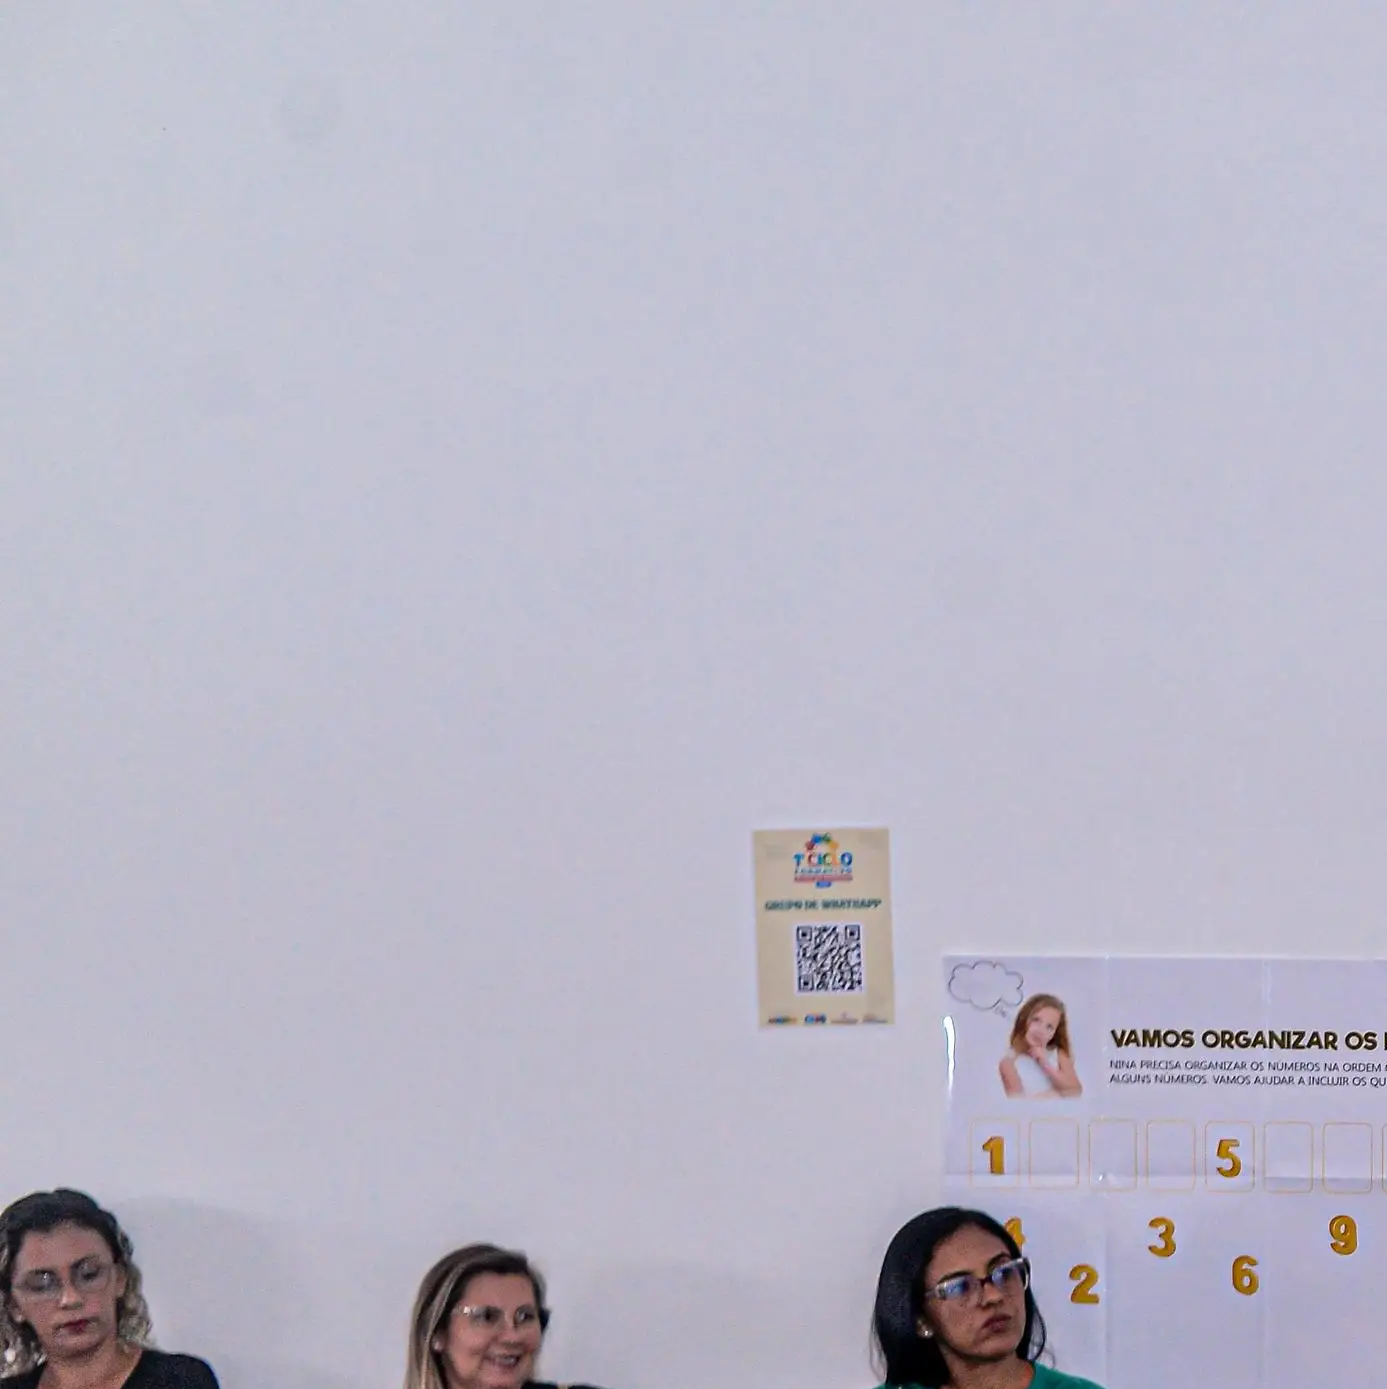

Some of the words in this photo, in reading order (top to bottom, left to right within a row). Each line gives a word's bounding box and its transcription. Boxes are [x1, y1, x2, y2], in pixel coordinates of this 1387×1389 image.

[1110, 1028, 1195, 1049] VAMOS
[1201, 1029, 1338, 1050] ORGANIZAR
[1345, 1031, 1377, 1051] OS
[1110, 1060, 1137, 1070] NINA
[1140, 1060, 1181, 1070] PRECISA
[1185, 1060, 1247, 1071] ORGANIZAR
[1251, 1061, 1264, 1071] OS
[1268, 1059, 1320, 1072] NÚMEROS
[1324, 1062, 1339, 1072] NA
[1343, 1062, 1381, 1073] ORDEM
[1110, 1074, 1151, 1084] ALGUNS
[1213, 1075, 1251, 1085] VAMOS
[1254, 1075, 1294, 1086] AJUDAR
[1297, 1076, 1305, 1085] A
[1308, 1076, 1349, 1086] INCLUIR
[1352, 1077, 1367, 1086] OS
[981, 1136, 1006, 1176] 1
[1215, 1138, 1242, 1179] 5
[1147, 1216, 1177, 1258] 3
[1329, 1215, 1358, 1256] 9
[1069, 1264, 1100, 1305] 2
[1232, 1255, 1259, 1296] 6
